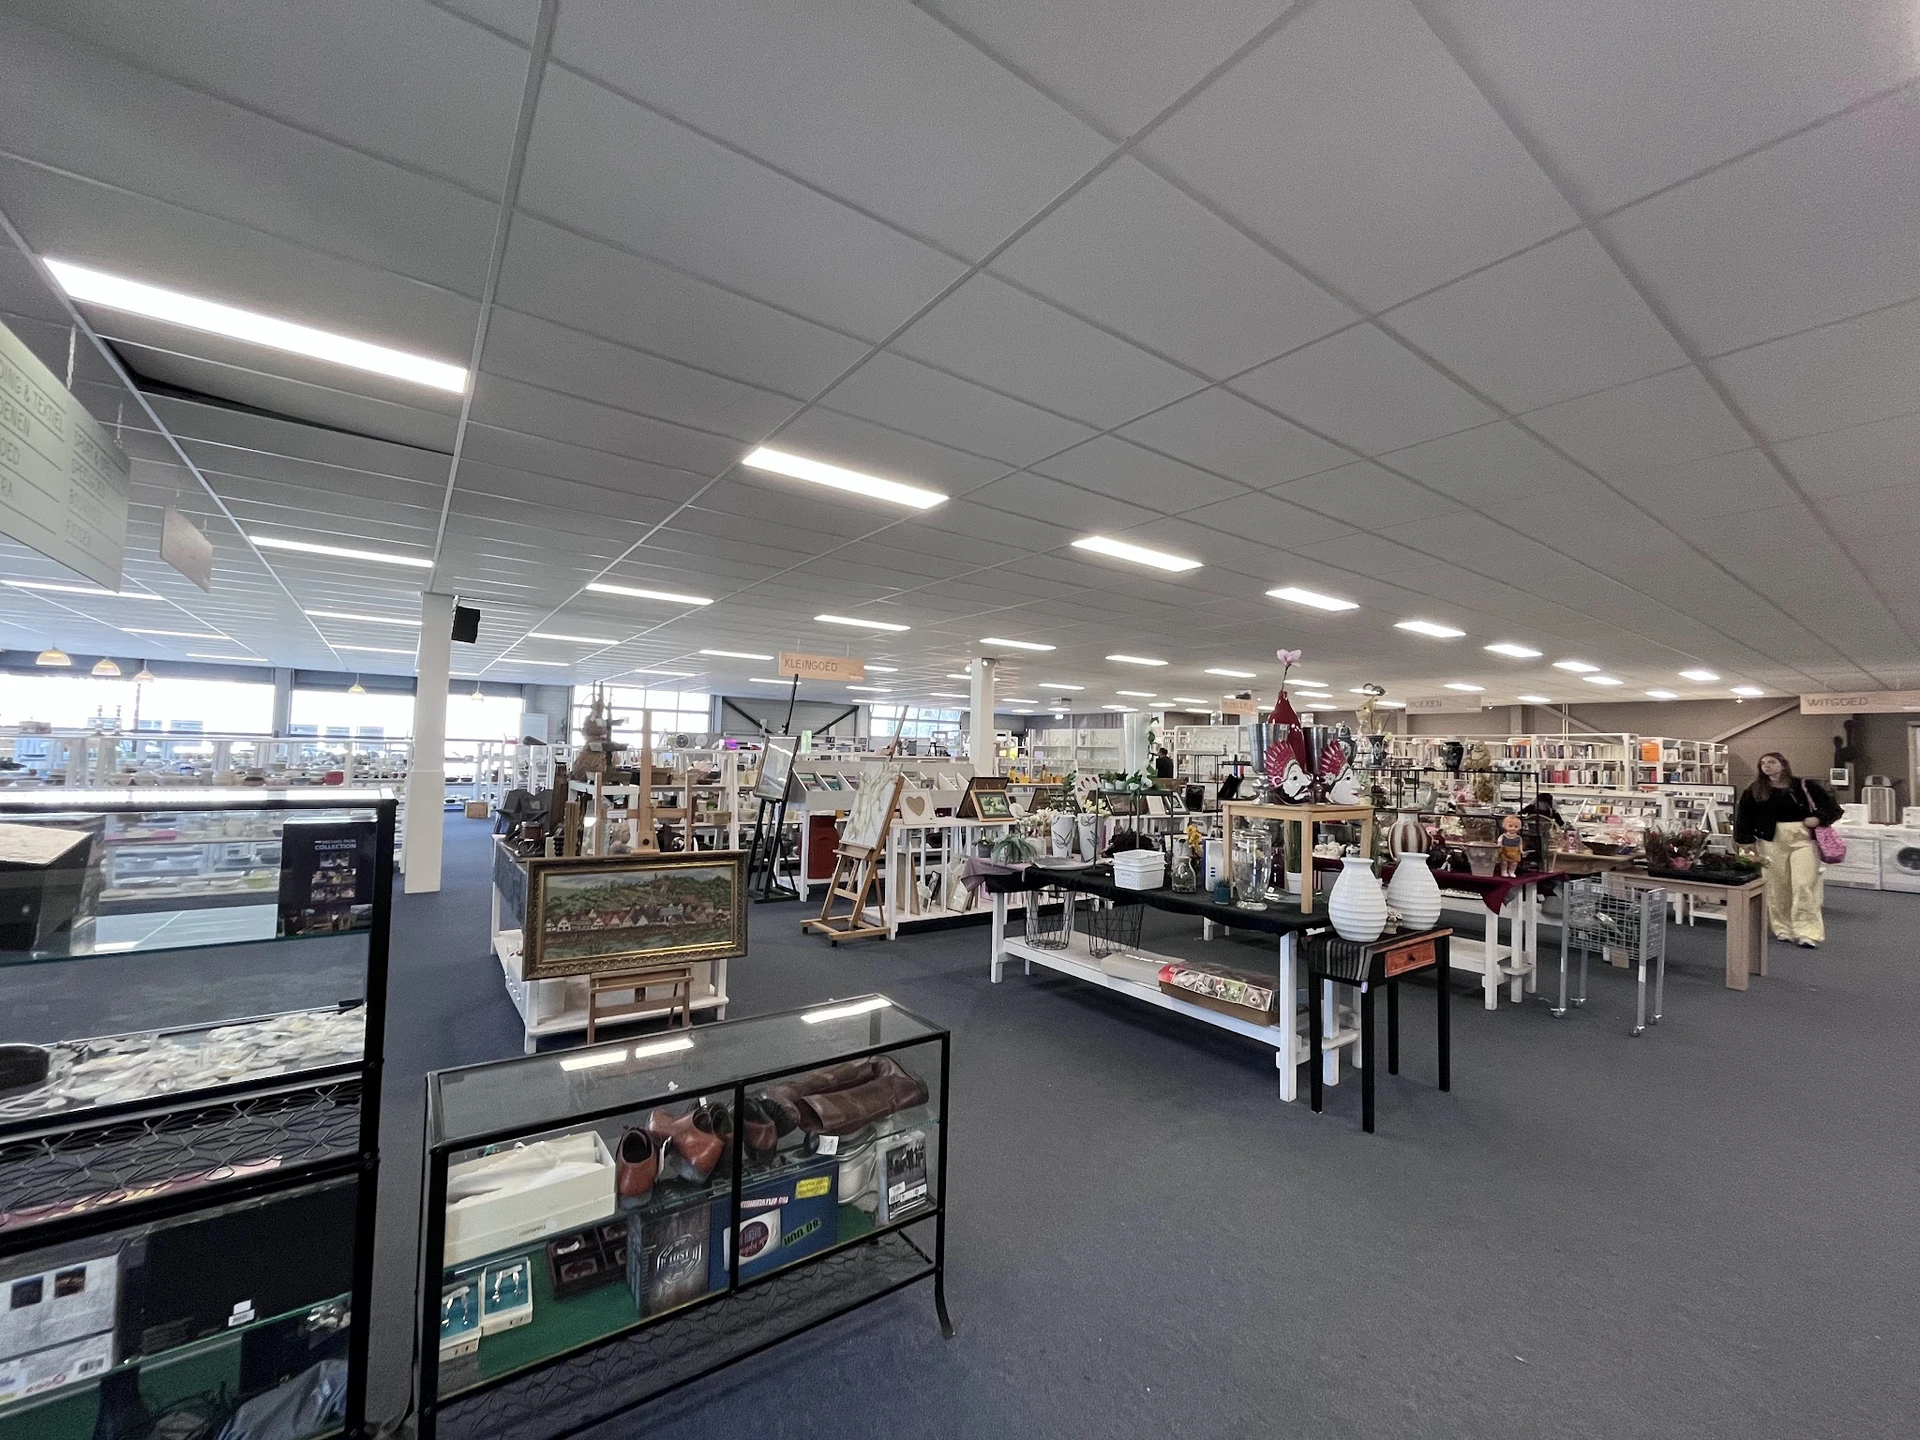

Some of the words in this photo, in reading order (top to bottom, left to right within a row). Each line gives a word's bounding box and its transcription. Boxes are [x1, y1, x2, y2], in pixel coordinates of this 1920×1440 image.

[784, 657, 838, 672] KLEINGOED
[1409, 699, 1442, 708] BOEKEN
[1807, 697, 1869, 707] WITGOED
